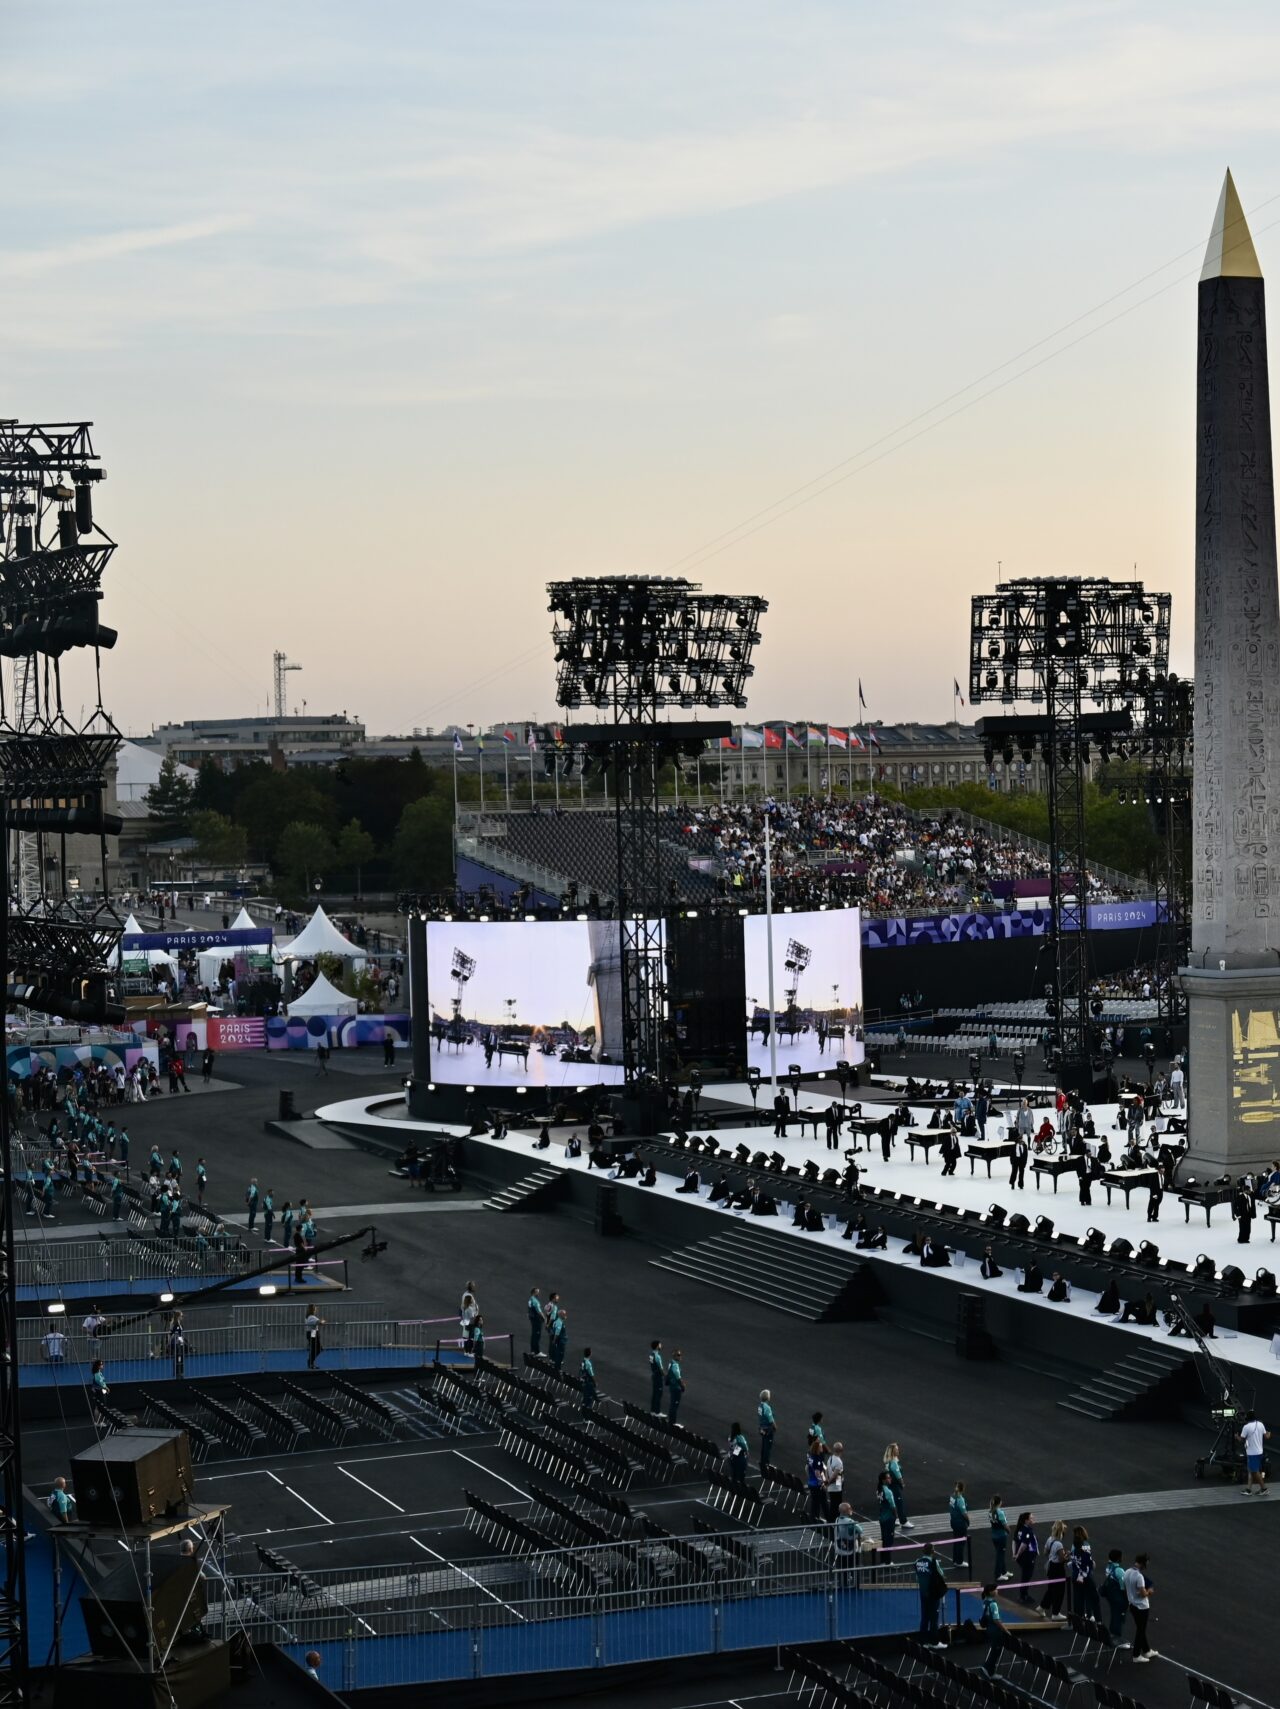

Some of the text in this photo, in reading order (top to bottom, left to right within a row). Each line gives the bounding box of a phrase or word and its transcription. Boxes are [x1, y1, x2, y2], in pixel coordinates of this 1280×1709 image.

[1098, 911, 1146, 923] PARIS 2024
[166, 935, 227, 945] PARIS 2024
[219, 1023, 250, 1033] PARIS
[220, 1034, 251, 1044] 2024
